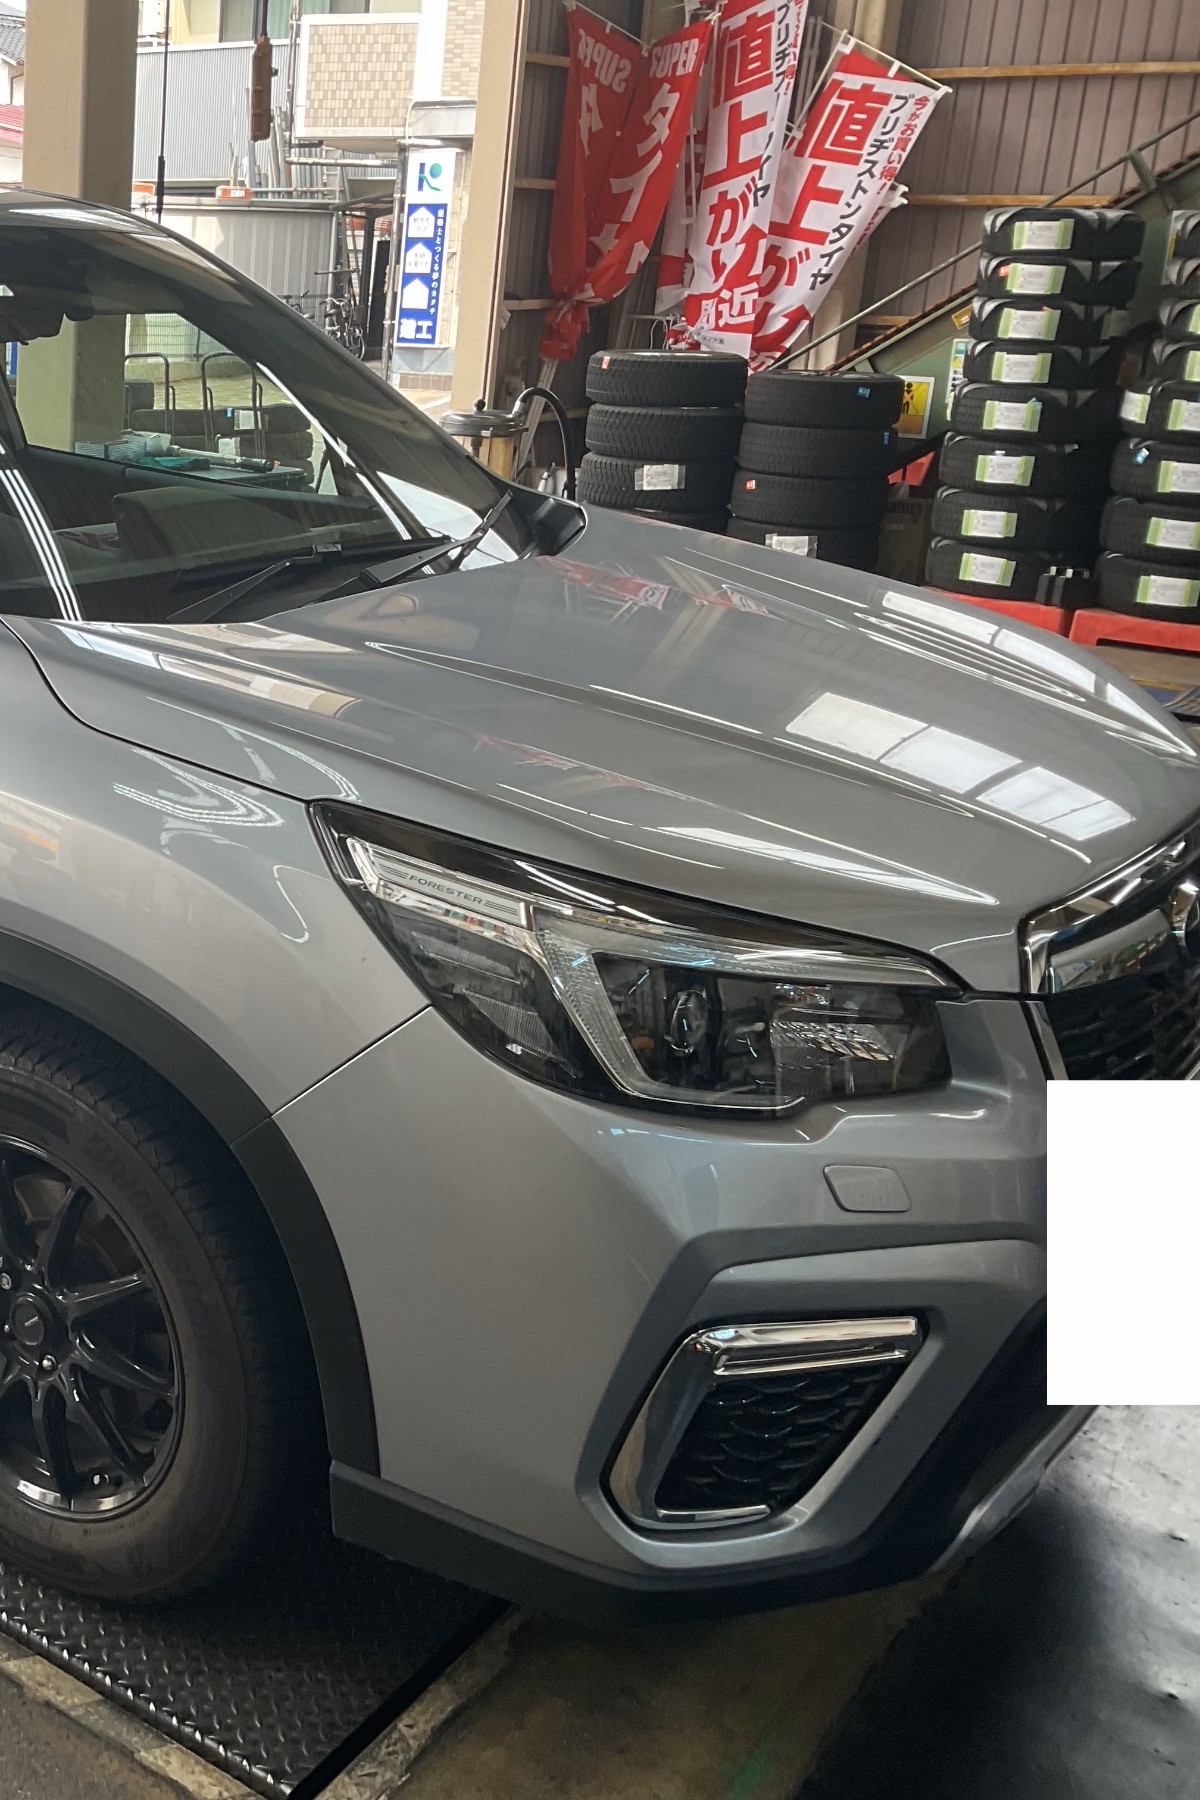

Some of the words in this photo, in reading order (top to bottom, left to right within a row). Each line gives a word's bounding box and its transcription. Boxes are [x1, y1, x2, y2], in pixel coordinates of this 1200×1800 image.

[650, 38, 699, 78] SUPER
[753, 0, 791, 206] ブリヂスイヤ
[809, 93, 915, 291] ブリヂストンタイヤ
[409, 875, 484, 905] FORESTER
